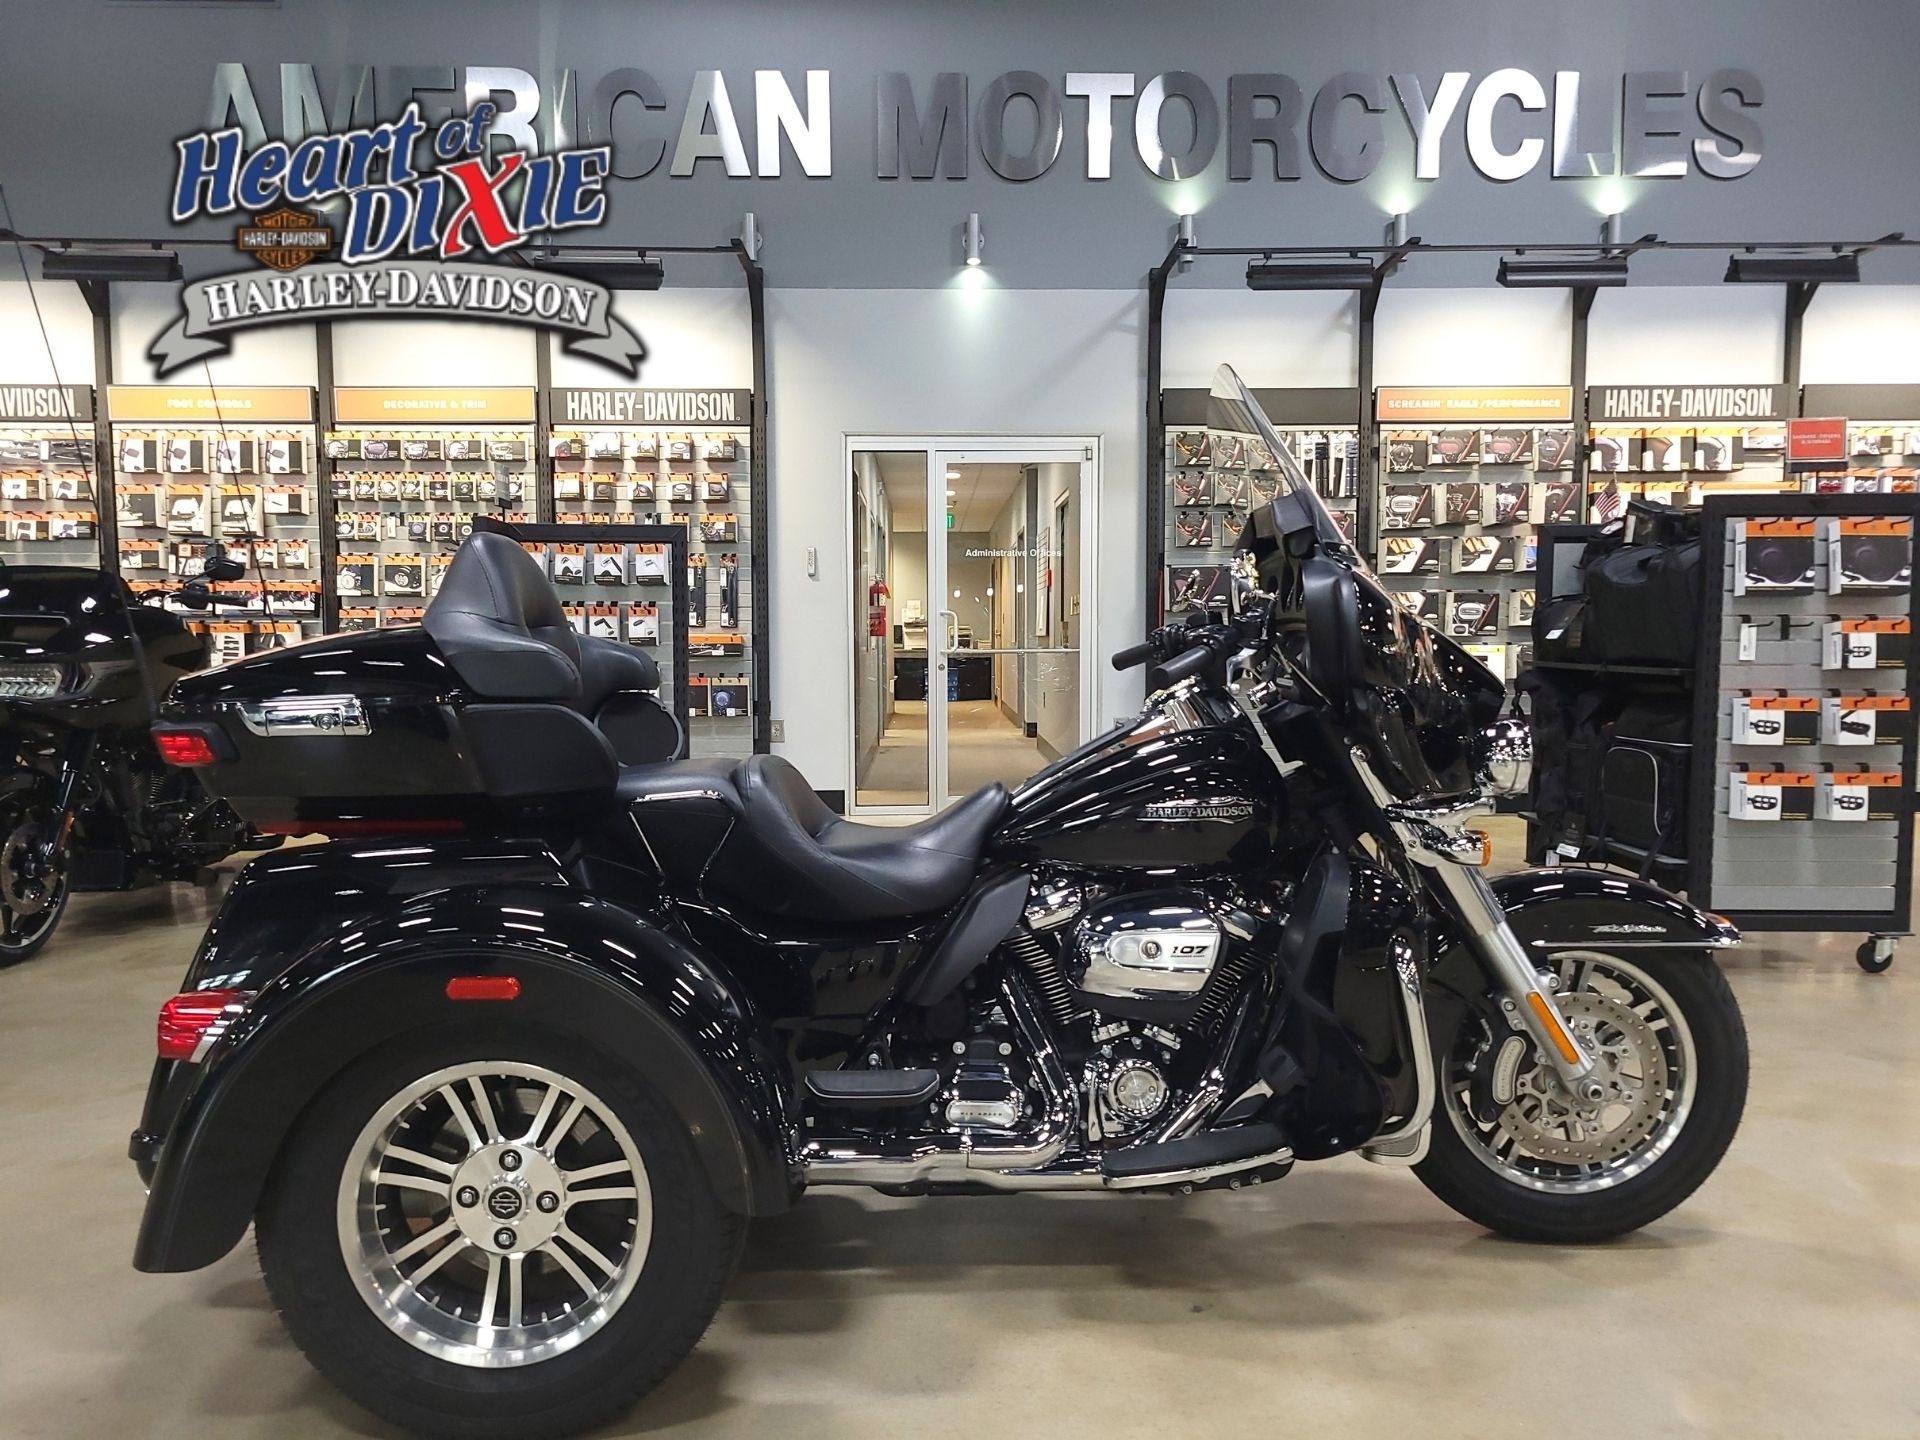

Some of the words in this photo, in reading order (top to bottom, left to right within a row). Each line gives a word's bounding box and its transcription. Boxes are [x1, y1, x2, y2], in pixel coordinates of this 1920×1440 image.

[876, 68, 1766, 182] MOTORCYCLES
[566, 391, 736, 421] HARLEY-DAVIDSON
[1604, 388, 1773, 418] HARLEY-DAVIDSON
[965, 548, 1027, 557] Administrative
[1145, 805, 1253, 818] HARLEY-DAVIDSON
[1172, 945, 1209, 954] 107
